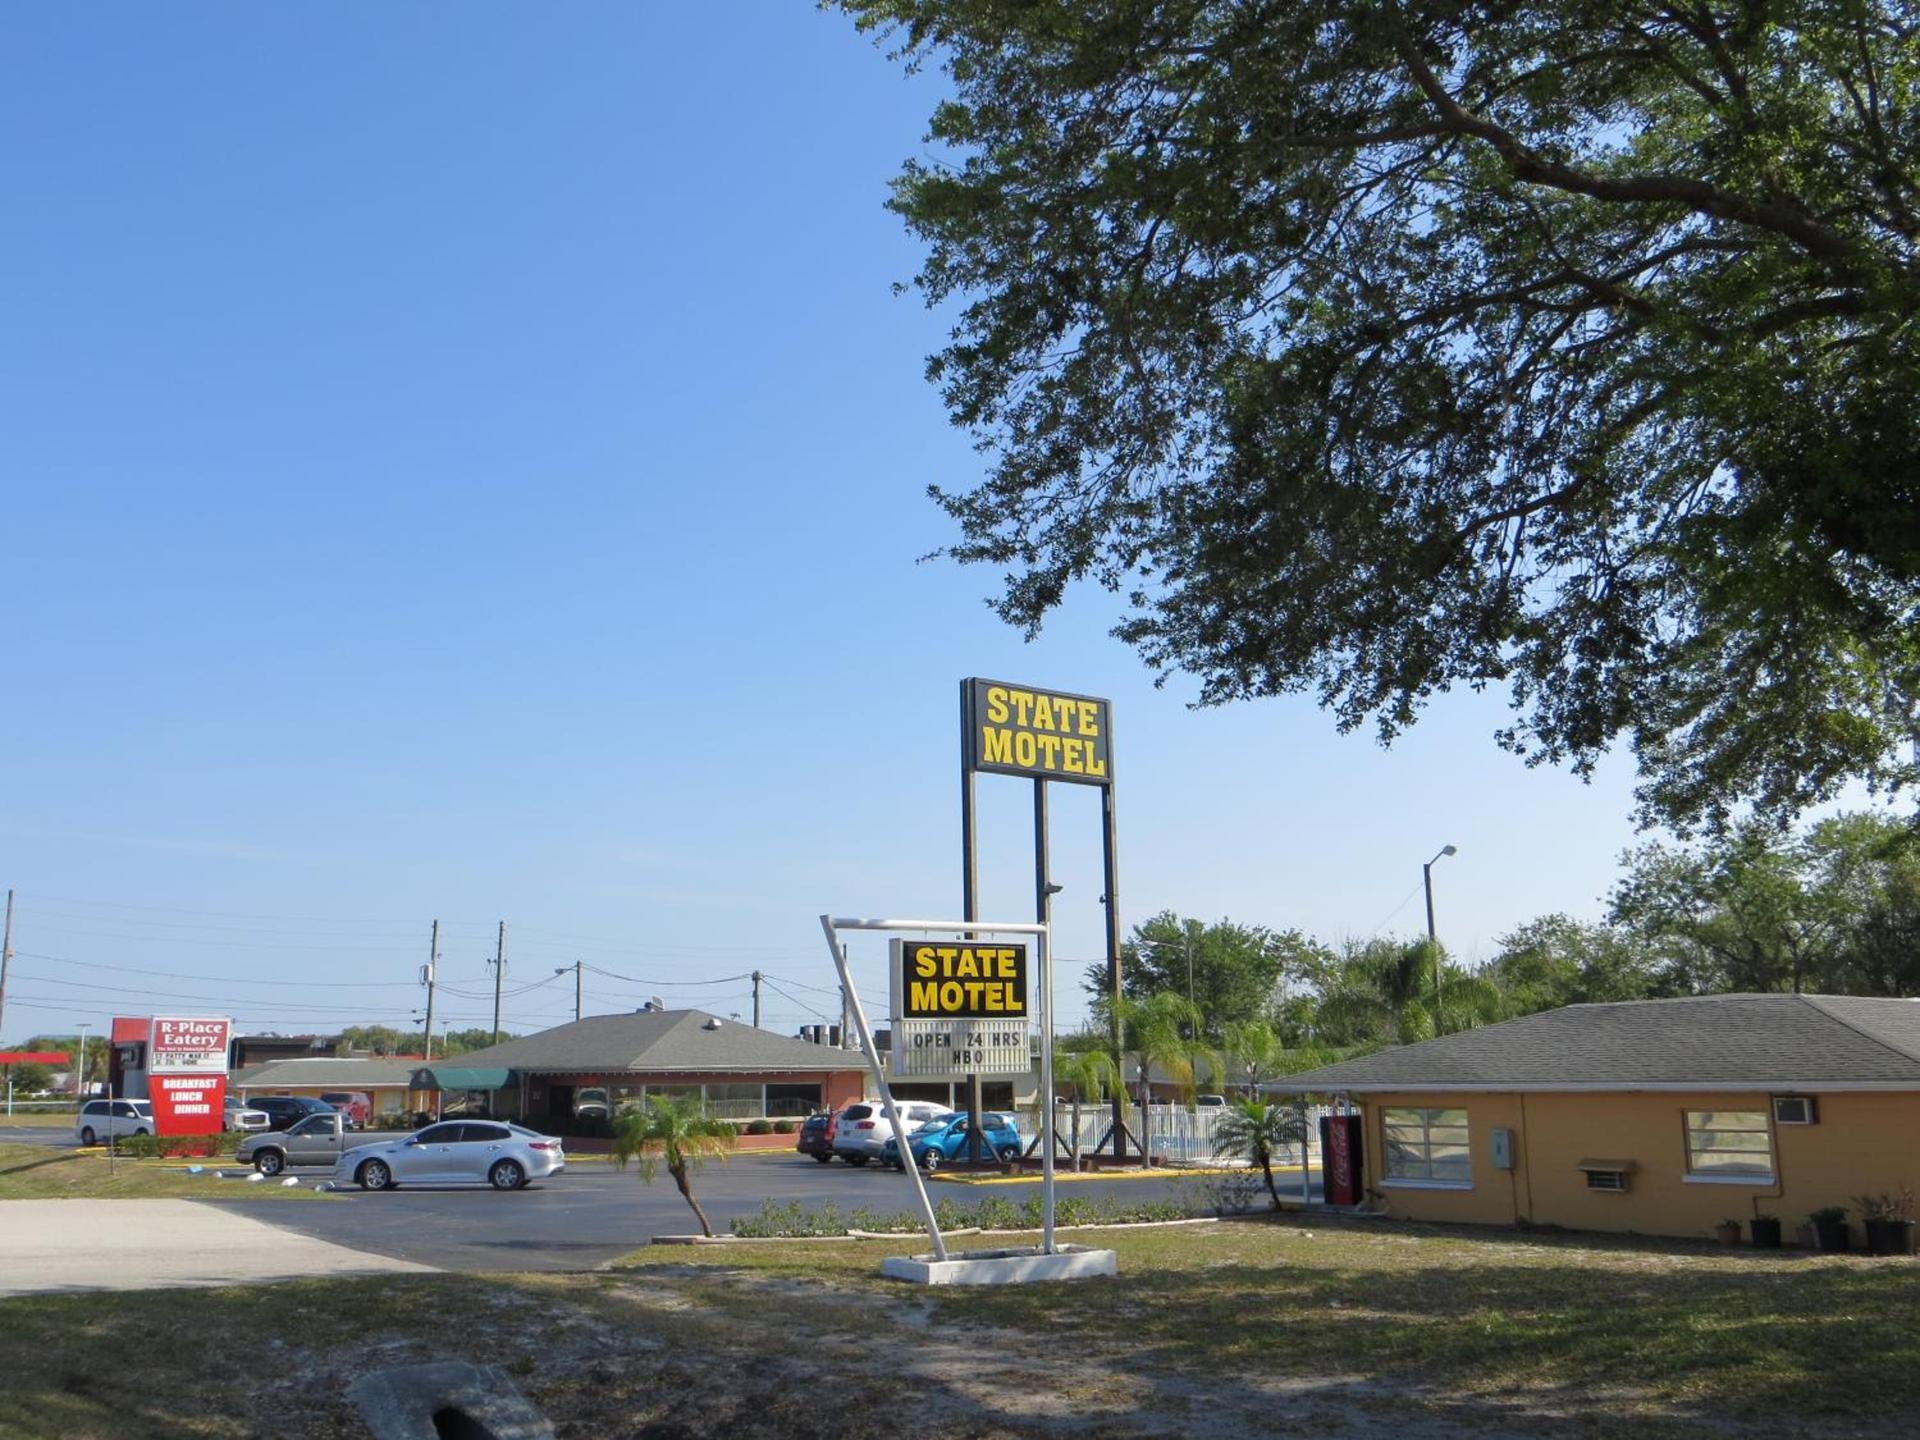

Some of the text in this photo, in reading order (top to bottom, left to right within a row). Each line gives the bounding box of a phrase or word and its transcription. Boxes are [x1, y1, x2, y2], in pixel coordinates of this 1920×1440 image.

[987, 687, 1099, 737] STATE
[982, 726, 1105, 777] MOTEL
[915, 947, 1017, 978] STATE
[910, 981, 1023, 1012] MOTEL
[161, 1022, 224, 1033] R-Place
[164, 1034, 217, 1047] Eatery
[914, 1032, 1019, 1048] OPEN 24 HRS
[953, 1050, 983, 1065] HBO
[163, 1079, 218, 1089] BREAKFAST
[170, 1091, 203, 1101] LUNCH
[174, 1104, 210, 1114] DINNER
